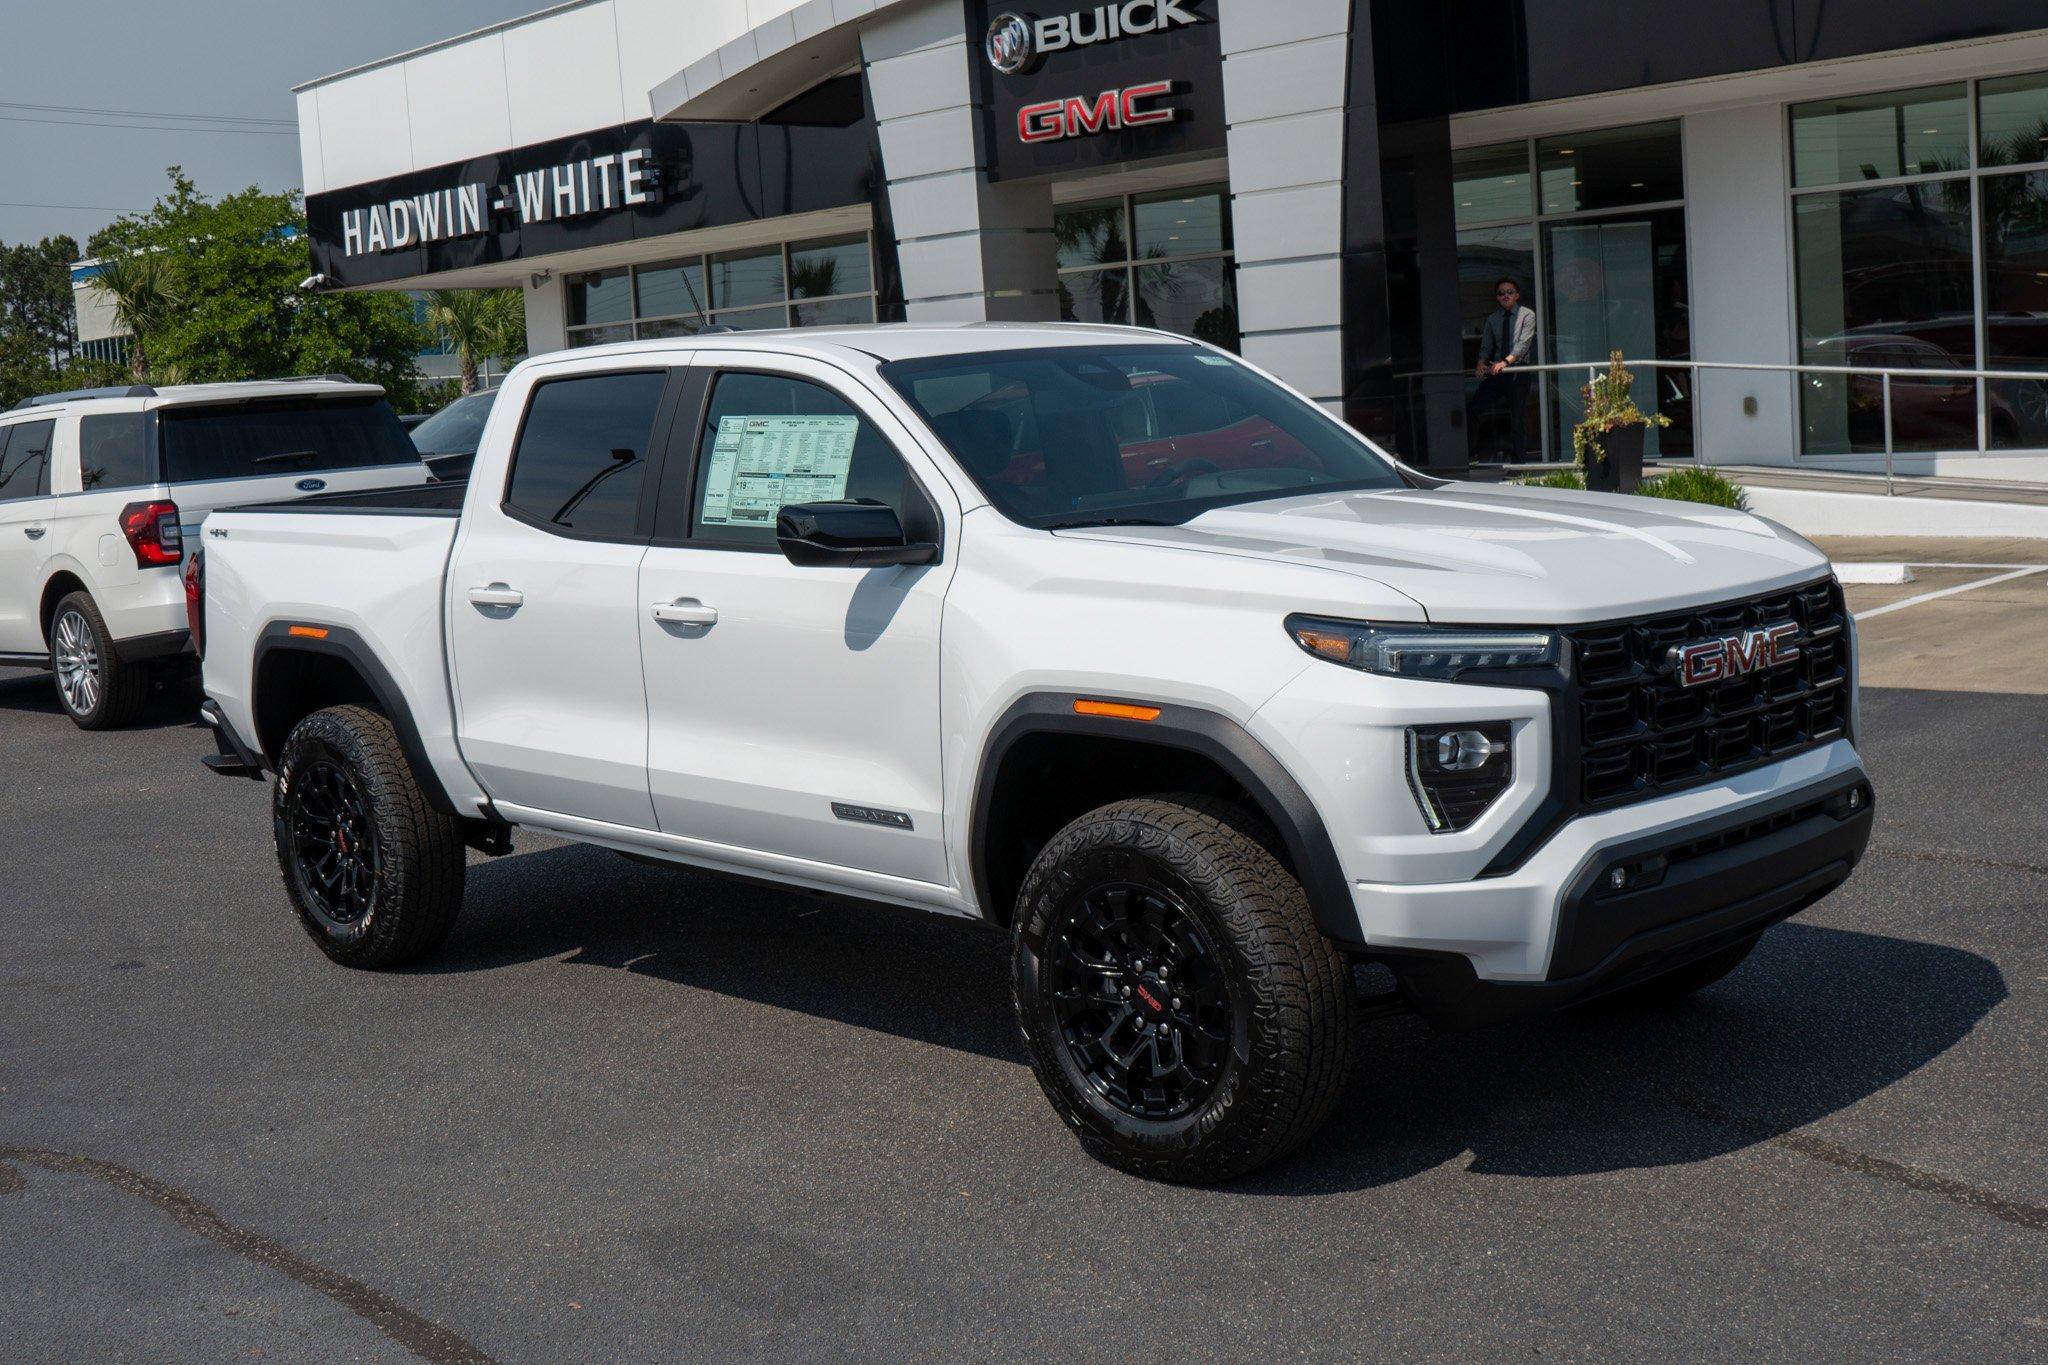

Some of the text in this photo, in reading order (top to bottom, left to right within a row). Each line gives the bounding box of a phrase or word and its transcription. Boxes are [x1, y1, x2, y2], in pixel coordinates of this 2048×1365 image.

[1034, 0, 1197, 53] BUICK
[1018, 79, 1175, 144] GMC
[1678, 621, 1800, 687] GMC
